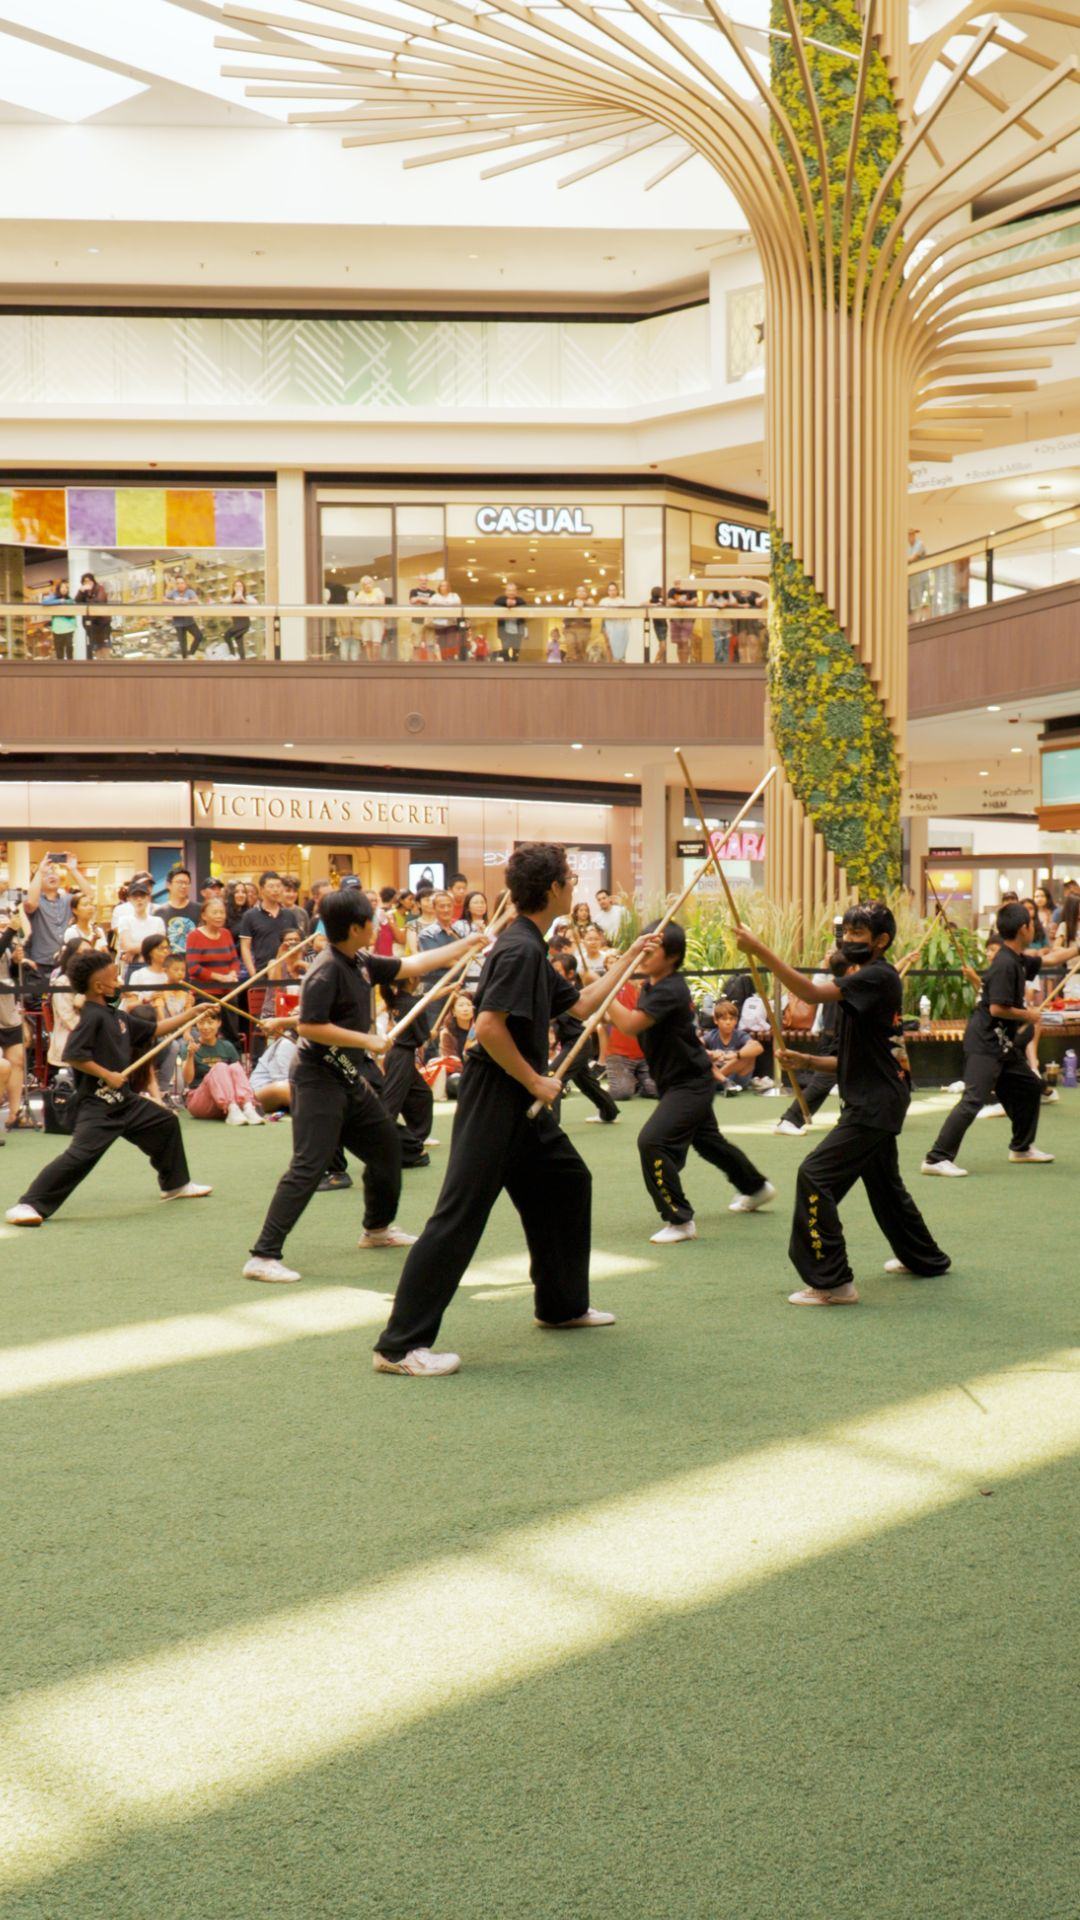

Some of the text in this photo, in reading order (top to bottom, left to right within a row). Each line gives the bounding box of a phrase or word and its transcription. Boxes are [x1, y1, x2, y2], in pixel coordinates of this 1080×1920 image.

[477, 507, 593, 534] CASUAL
[915, 793, 938, 802] Macy's
[198, 791, 449, 825] VICTORIA'S SECRET
[989, 801, 1008, 809] H&M
[220, 854, 276, 868] VICTORIA'S
